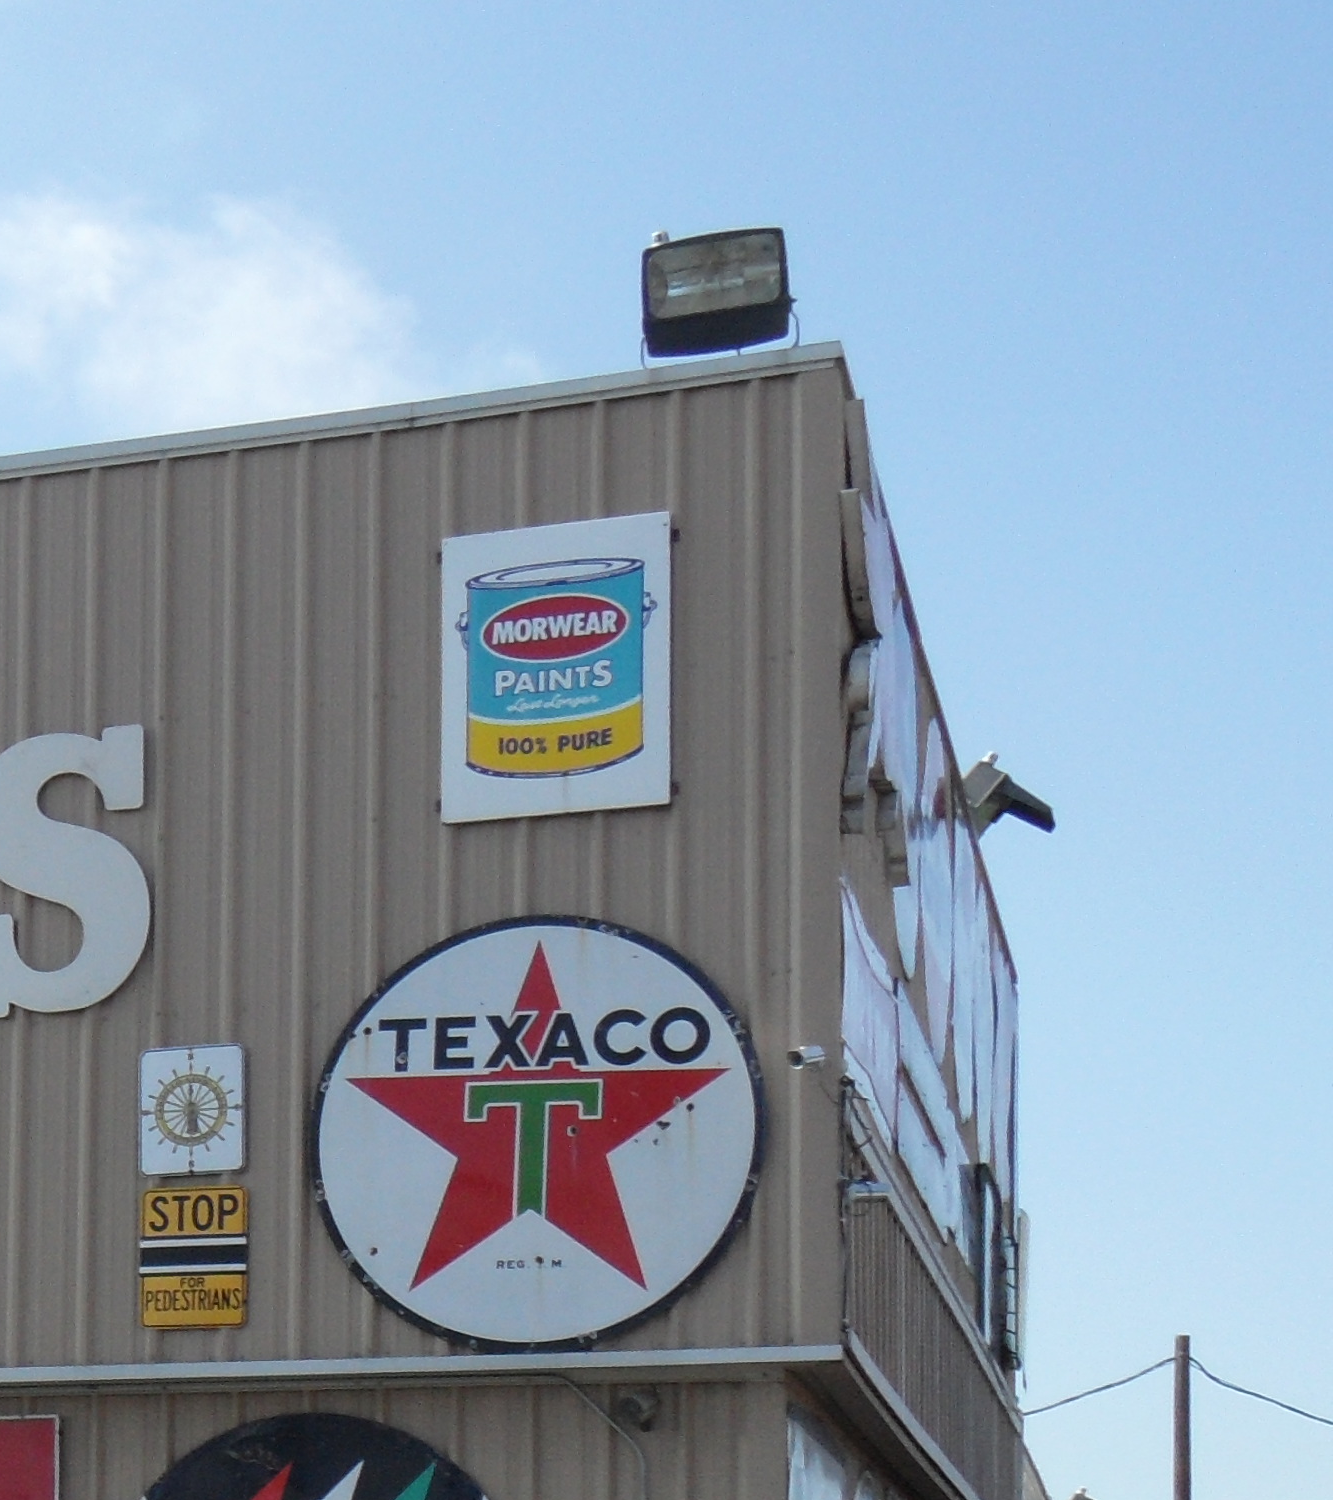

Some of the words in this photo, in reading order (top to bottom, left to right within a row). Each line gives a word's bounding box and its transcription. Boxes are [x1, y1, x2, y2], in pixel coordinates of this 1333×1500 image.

[491, 610, 618, 646] MORWEAR
[494, 659, 614, 697] PAINTS
[498, 737, 548, 755] 100%
[557, 728, 613, 752] PURE
[378, 1006, 711, 1072] TEXACO
[148, 1193, 239, 1233] STOP
[144, 1287, 242, 1313] PEDESTRIANS
[179, 1277, 206, 1289] FOR
